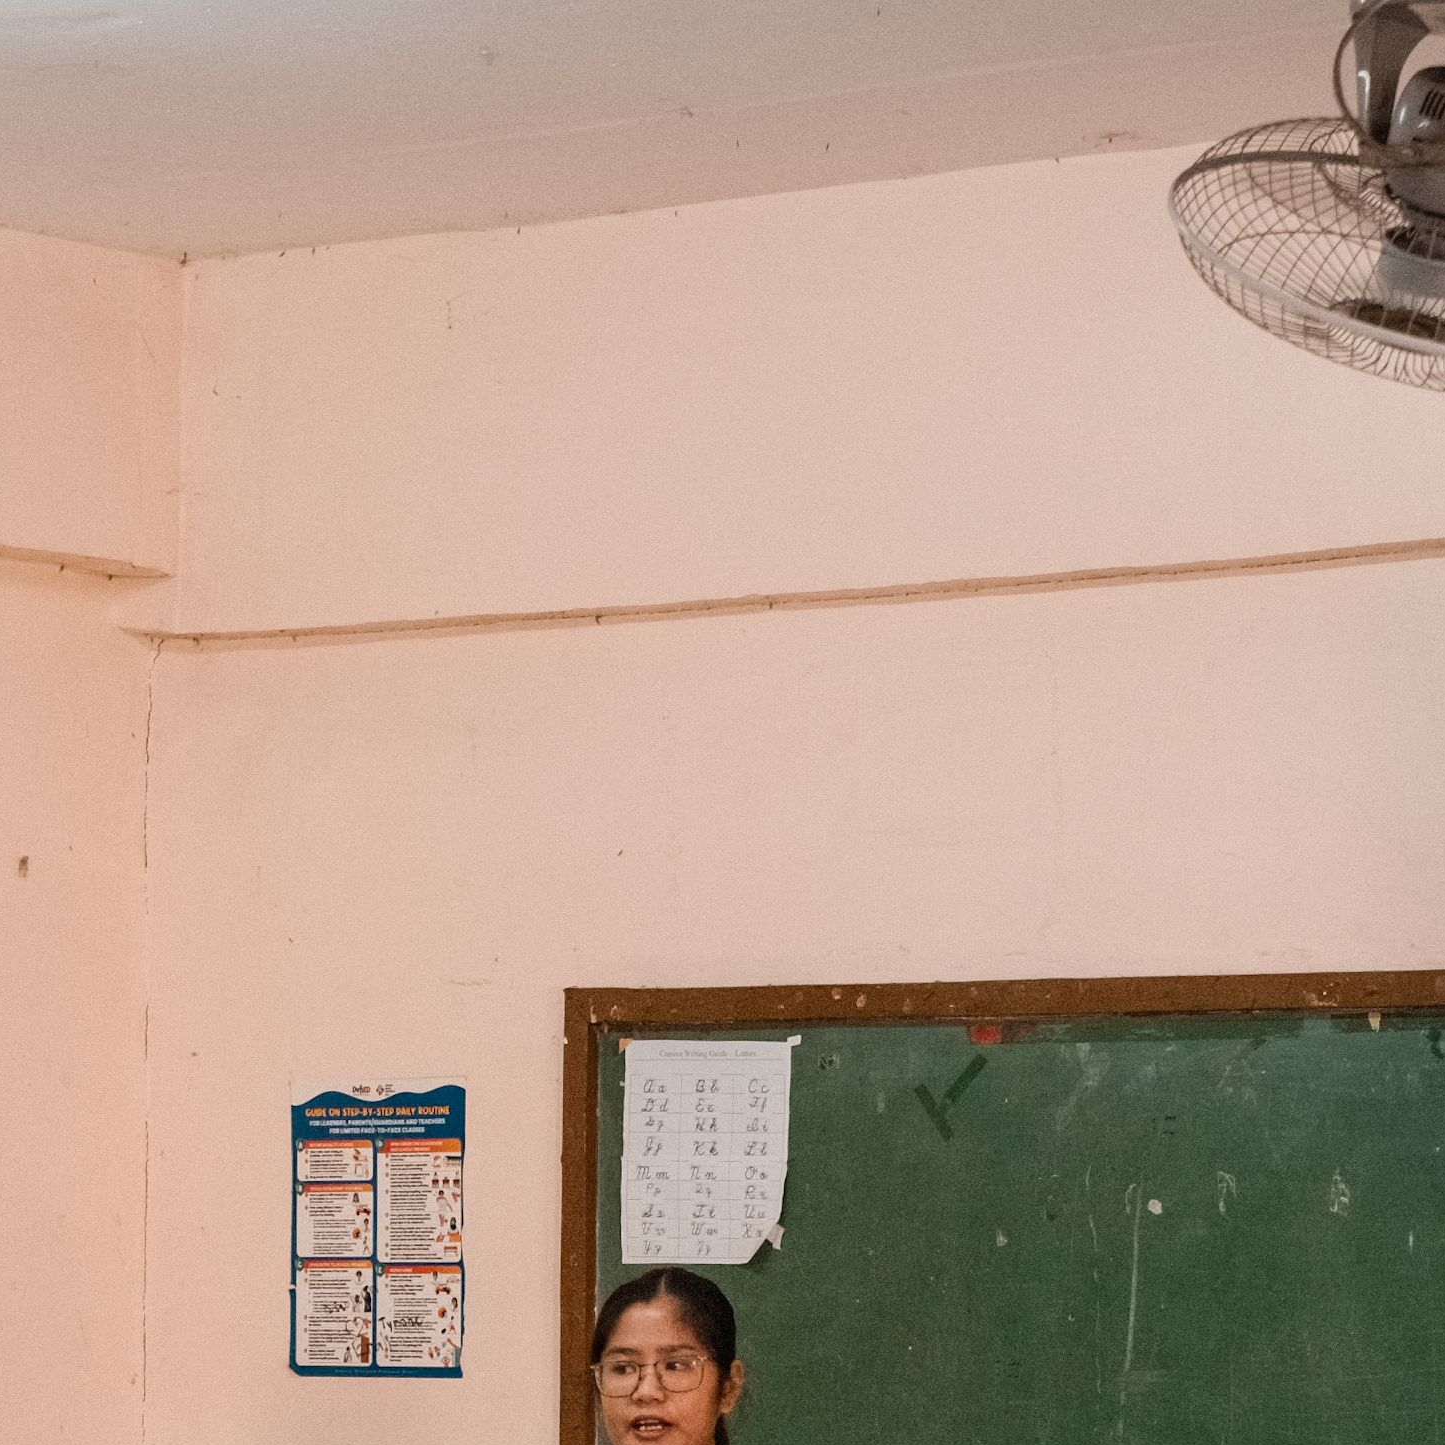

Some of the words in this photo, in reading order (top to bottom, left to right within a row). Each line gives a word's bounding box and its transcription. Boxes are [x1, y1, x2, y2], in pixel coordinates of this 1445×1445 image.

[305, 1108, 327, 1117] GUIDE
[329, 1108, 340, 1117] ON
[342, 1107, 394, 1117] STEP-BY-STEP
[396, 1106, 415, 1116] DAILY
[418, 1105, 450, 1115] ROUTINE
